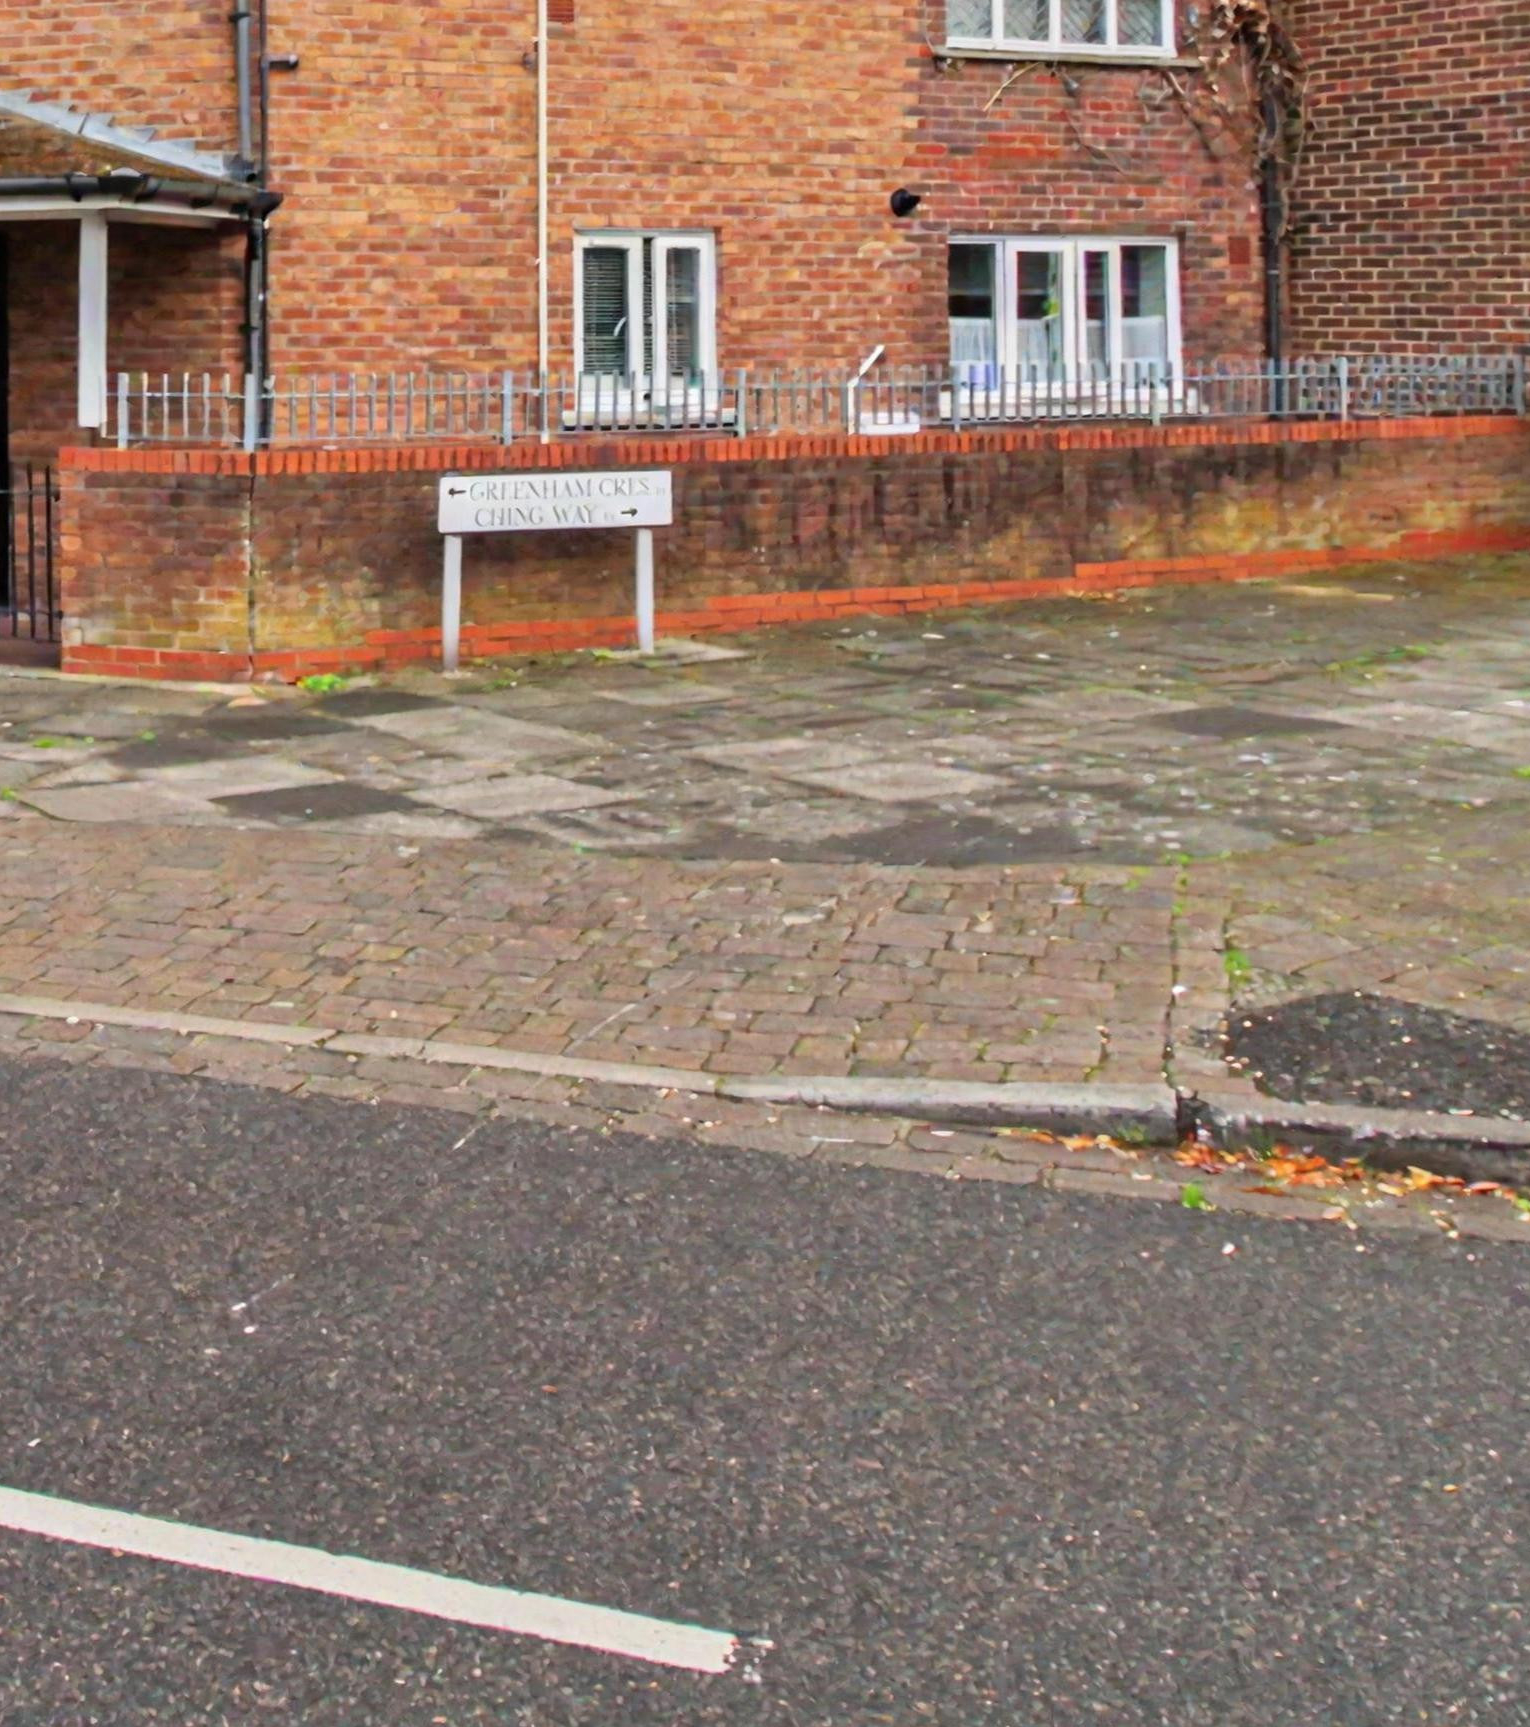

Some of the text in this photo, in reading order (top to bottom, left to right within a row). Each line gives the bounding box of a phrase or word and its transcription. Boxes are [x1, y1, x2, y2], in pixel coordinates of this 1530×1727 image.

[469, 478, 592, 502] GREENHAM
[598, 477, 651, 498] CRES
[474, 505, 543, 528] CHING
[552, 503, 599, 524] WAY
